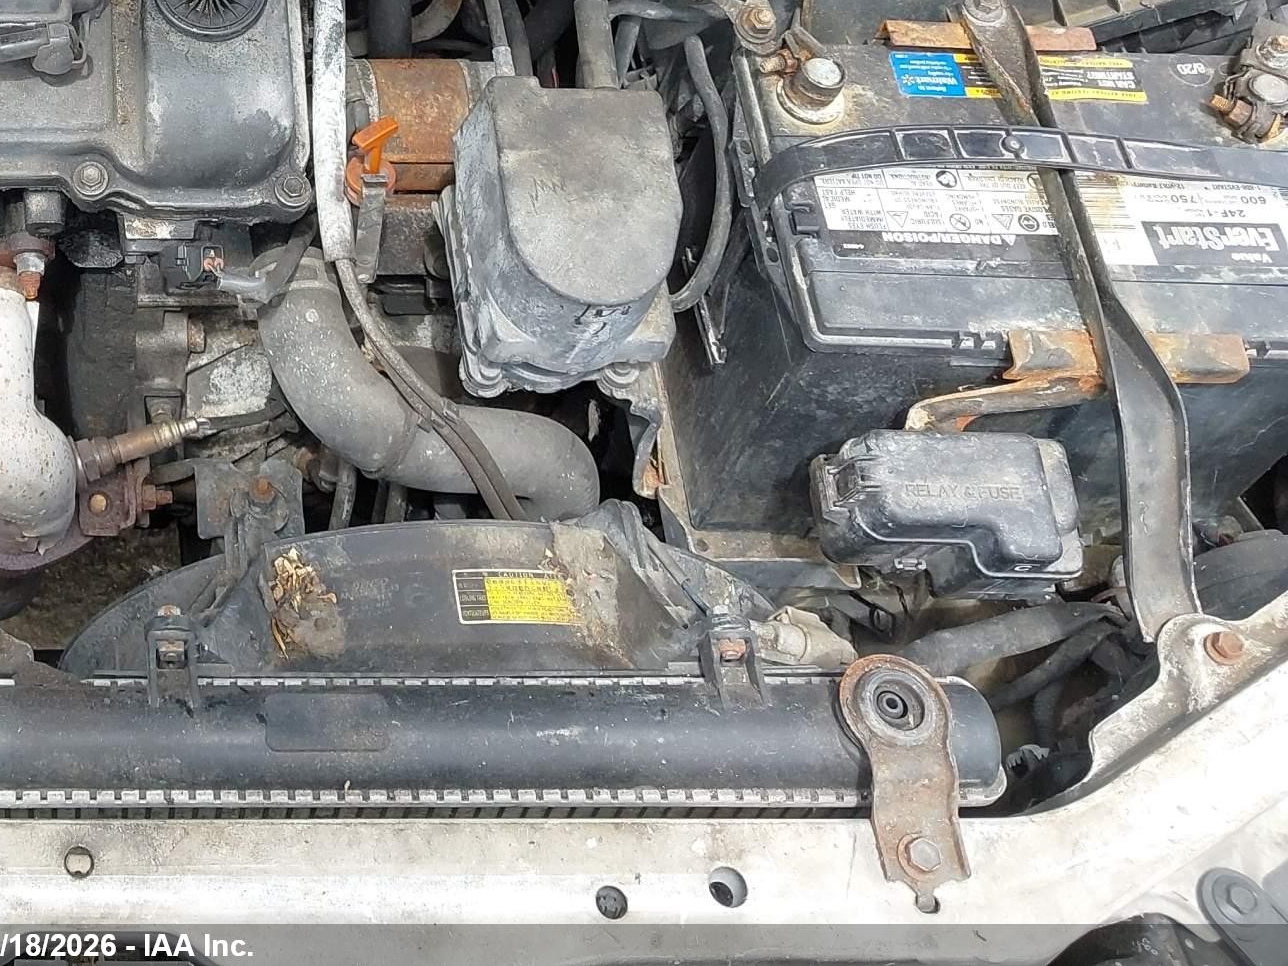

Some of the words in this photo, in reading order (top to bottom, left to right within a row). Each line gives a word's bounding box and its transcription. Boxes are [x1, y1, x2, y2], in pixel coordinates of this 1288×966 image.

[915, 76, 958, 86] Walmart
[1170, 194, 1198, 204] 750
[1240, 195, 1267, 205] 600
[1152, 225, 1281, 252] EverStart
[1230, 252, 1273, 264] Value
[904, 483, 959, 498] RELAY
[978, 484, 1024, 501] FUSE
